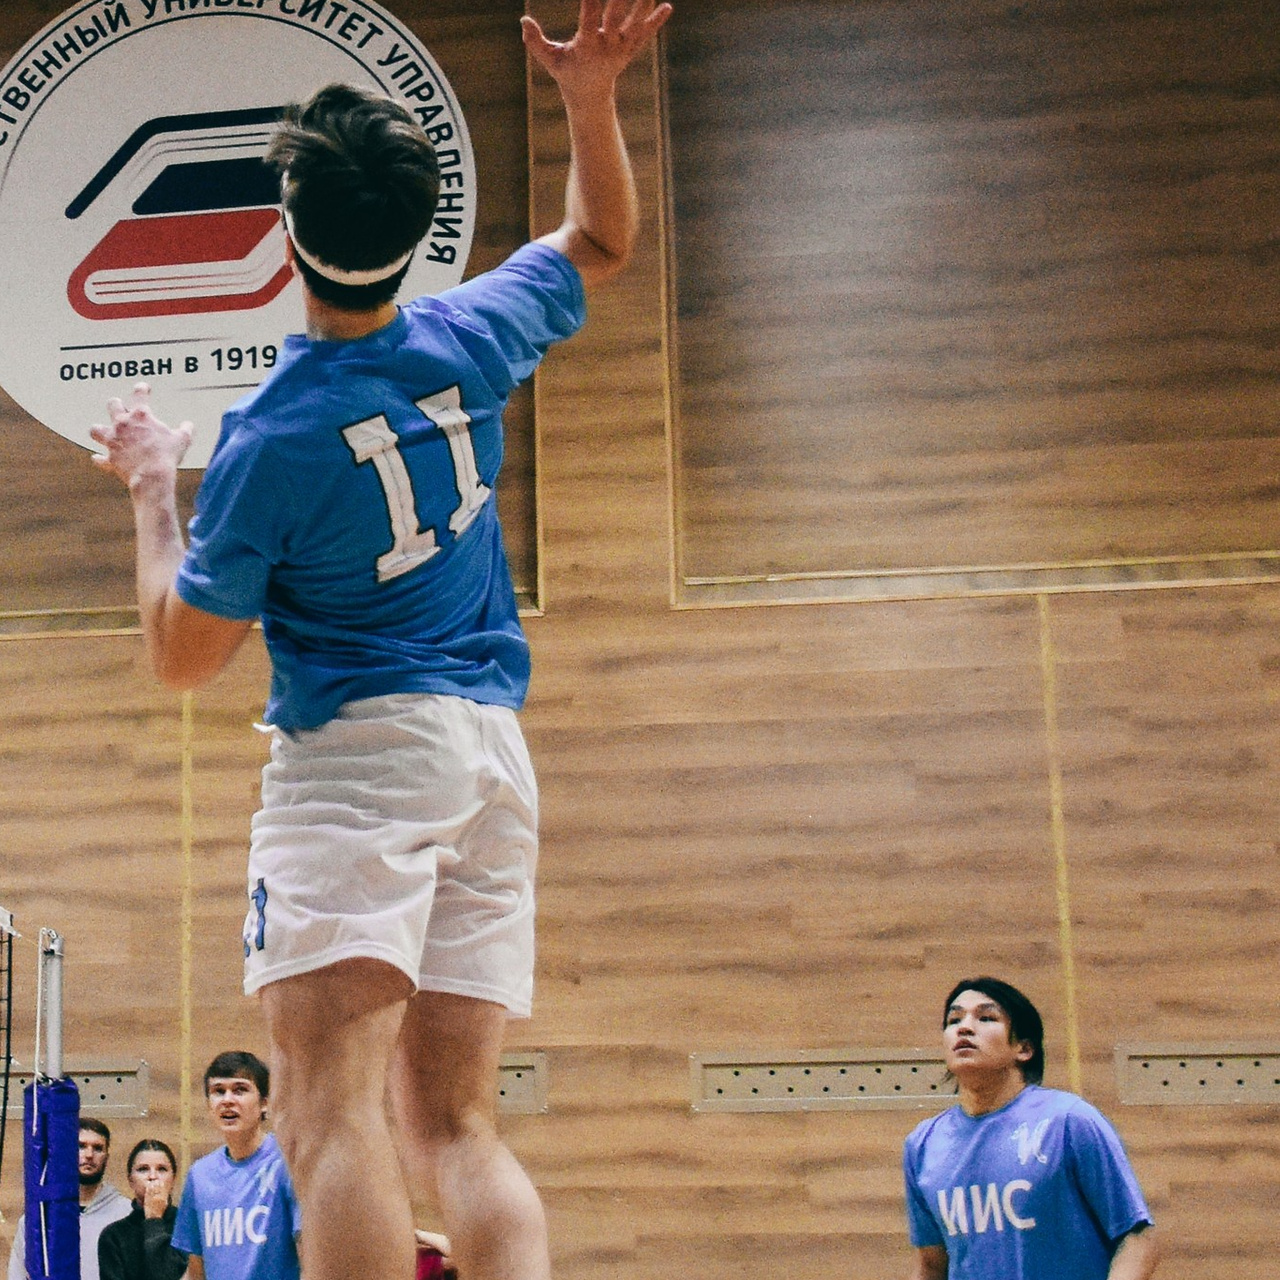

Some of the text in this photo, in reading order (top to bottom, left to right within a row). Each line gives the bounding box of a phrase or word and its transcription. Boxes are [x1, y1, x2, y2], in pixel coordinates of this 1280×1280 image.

[376, 43, 465, 265] УПРАВЛЕНИЯ
[59, 344, 278, 381] основан в 1919
[340, 383, 492, 584] 11
[204, 1204, 272, 1248] ИИС
[936, 1179, 1037, 1237] ИИС
